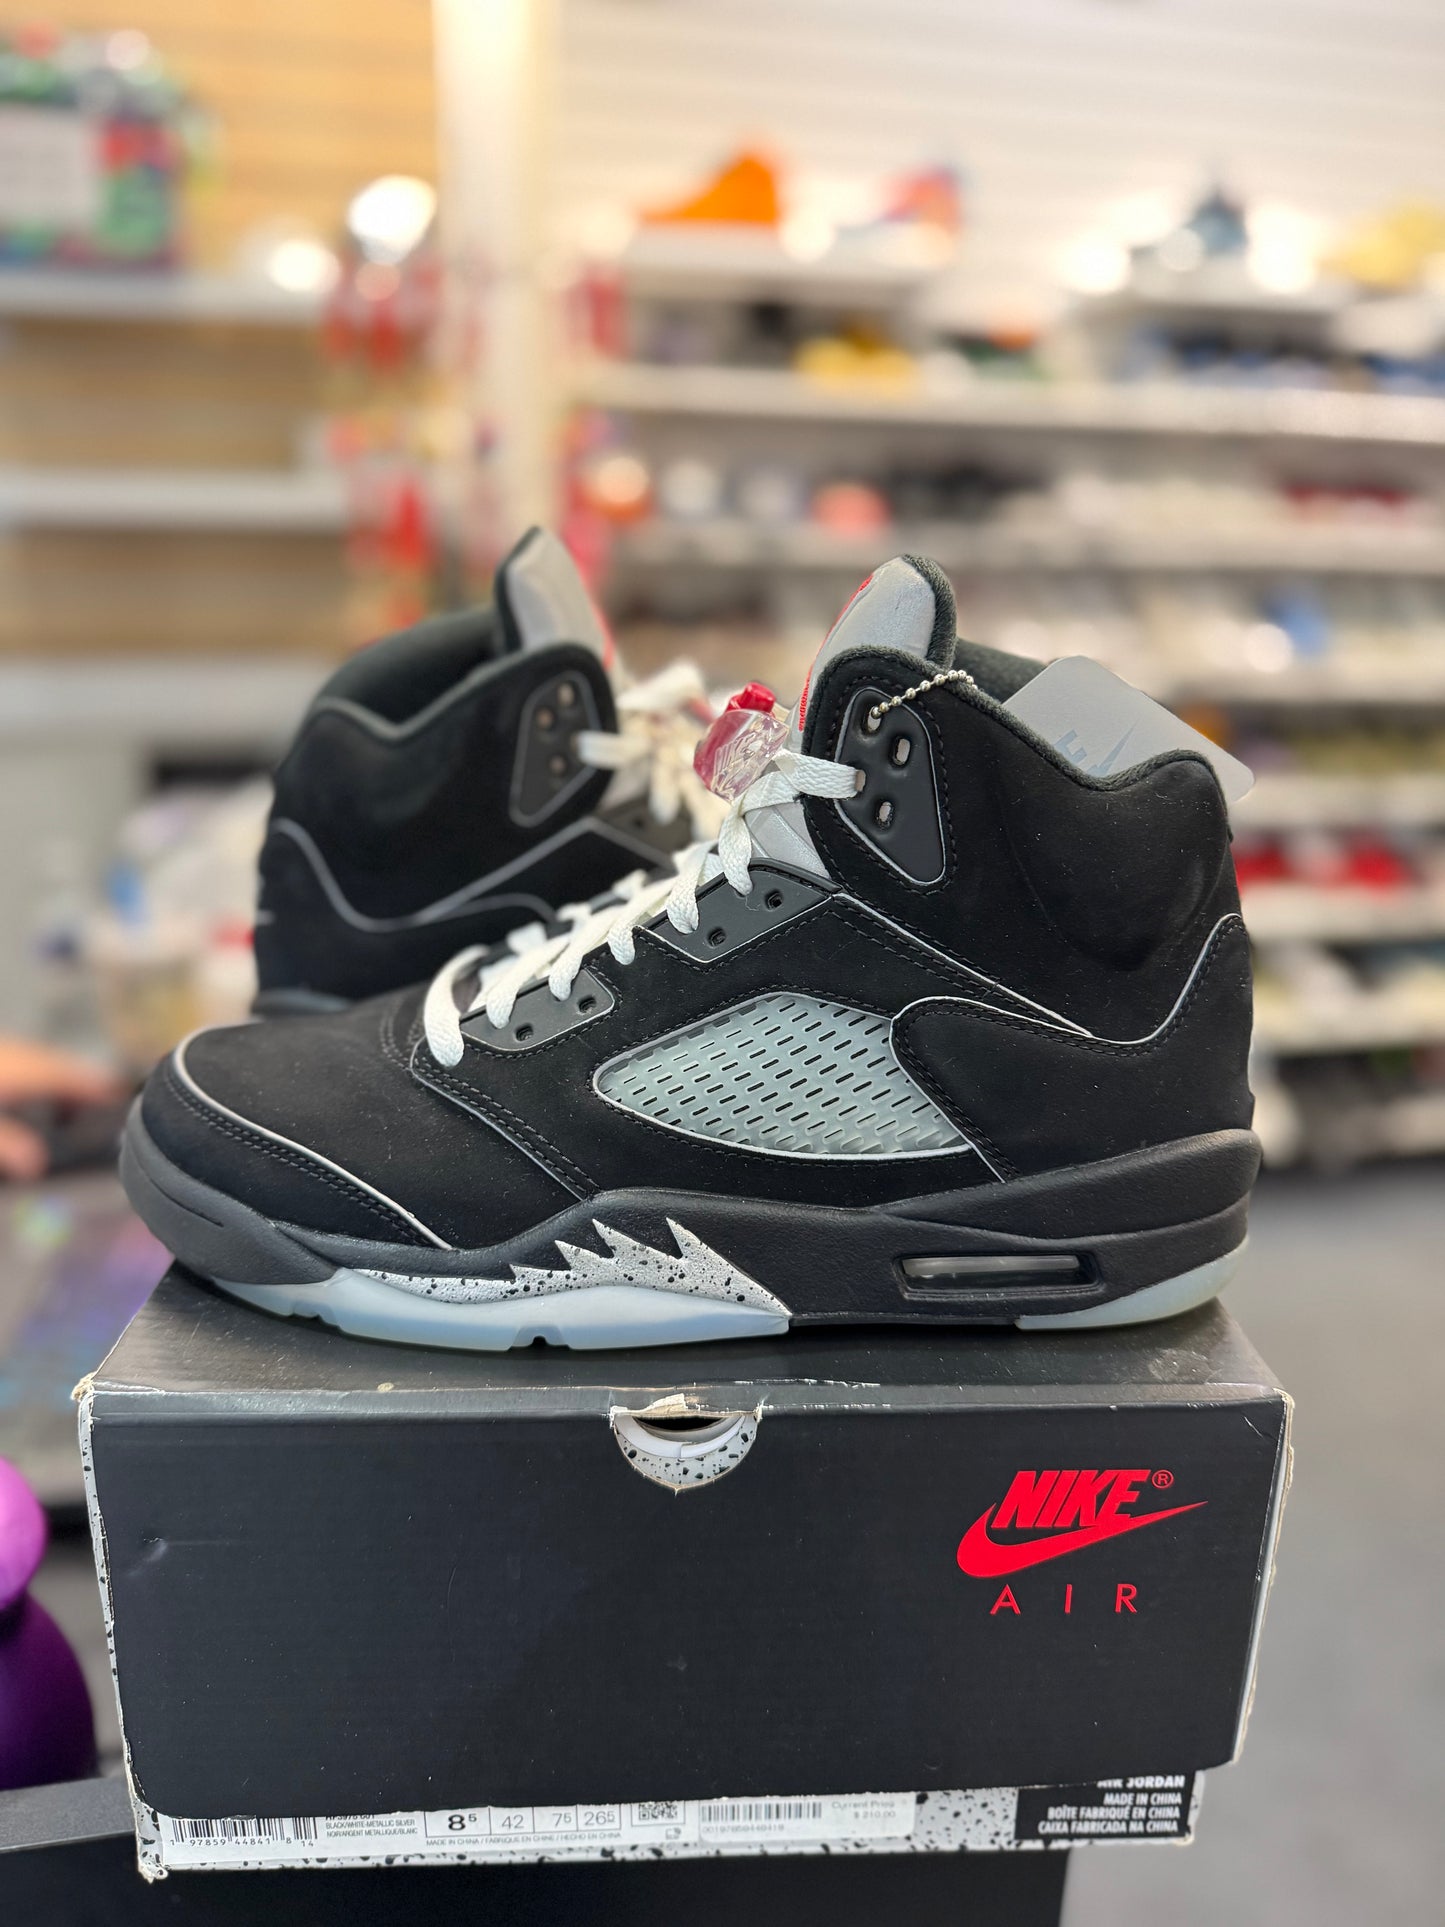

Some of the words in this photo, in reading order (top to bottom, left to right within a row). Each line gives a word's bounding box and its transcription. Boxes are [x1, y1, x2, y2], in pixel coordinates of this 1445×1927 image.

[1126, 1775, 1185, 1788] JORDAN
[1103, 1792, 1135, 1805] MADE
[1135, 1792, 1149, 1805] IN
[1150, 1792, 1182, 1805] CHINA
[1047, 1804, 1078, 1820] BOÎTE
[1079, 1804, 1130, 1820] FABRIQUÉ
[1131, 1807, 1146, 1819] EN
[1148, 1806, 1180, 1819] CHINA
[396, 1819, 416, 1827] SILVER
[501, 1814, 524, 1830] 42
[1038, 1821, 1069, 1834] CAIXA
[1070, 1821, 1127, 1834] FABRICADA
[1129, 1821, 1144, 1833] NA
[1146, 1820, 1178, 1833] CHINA
